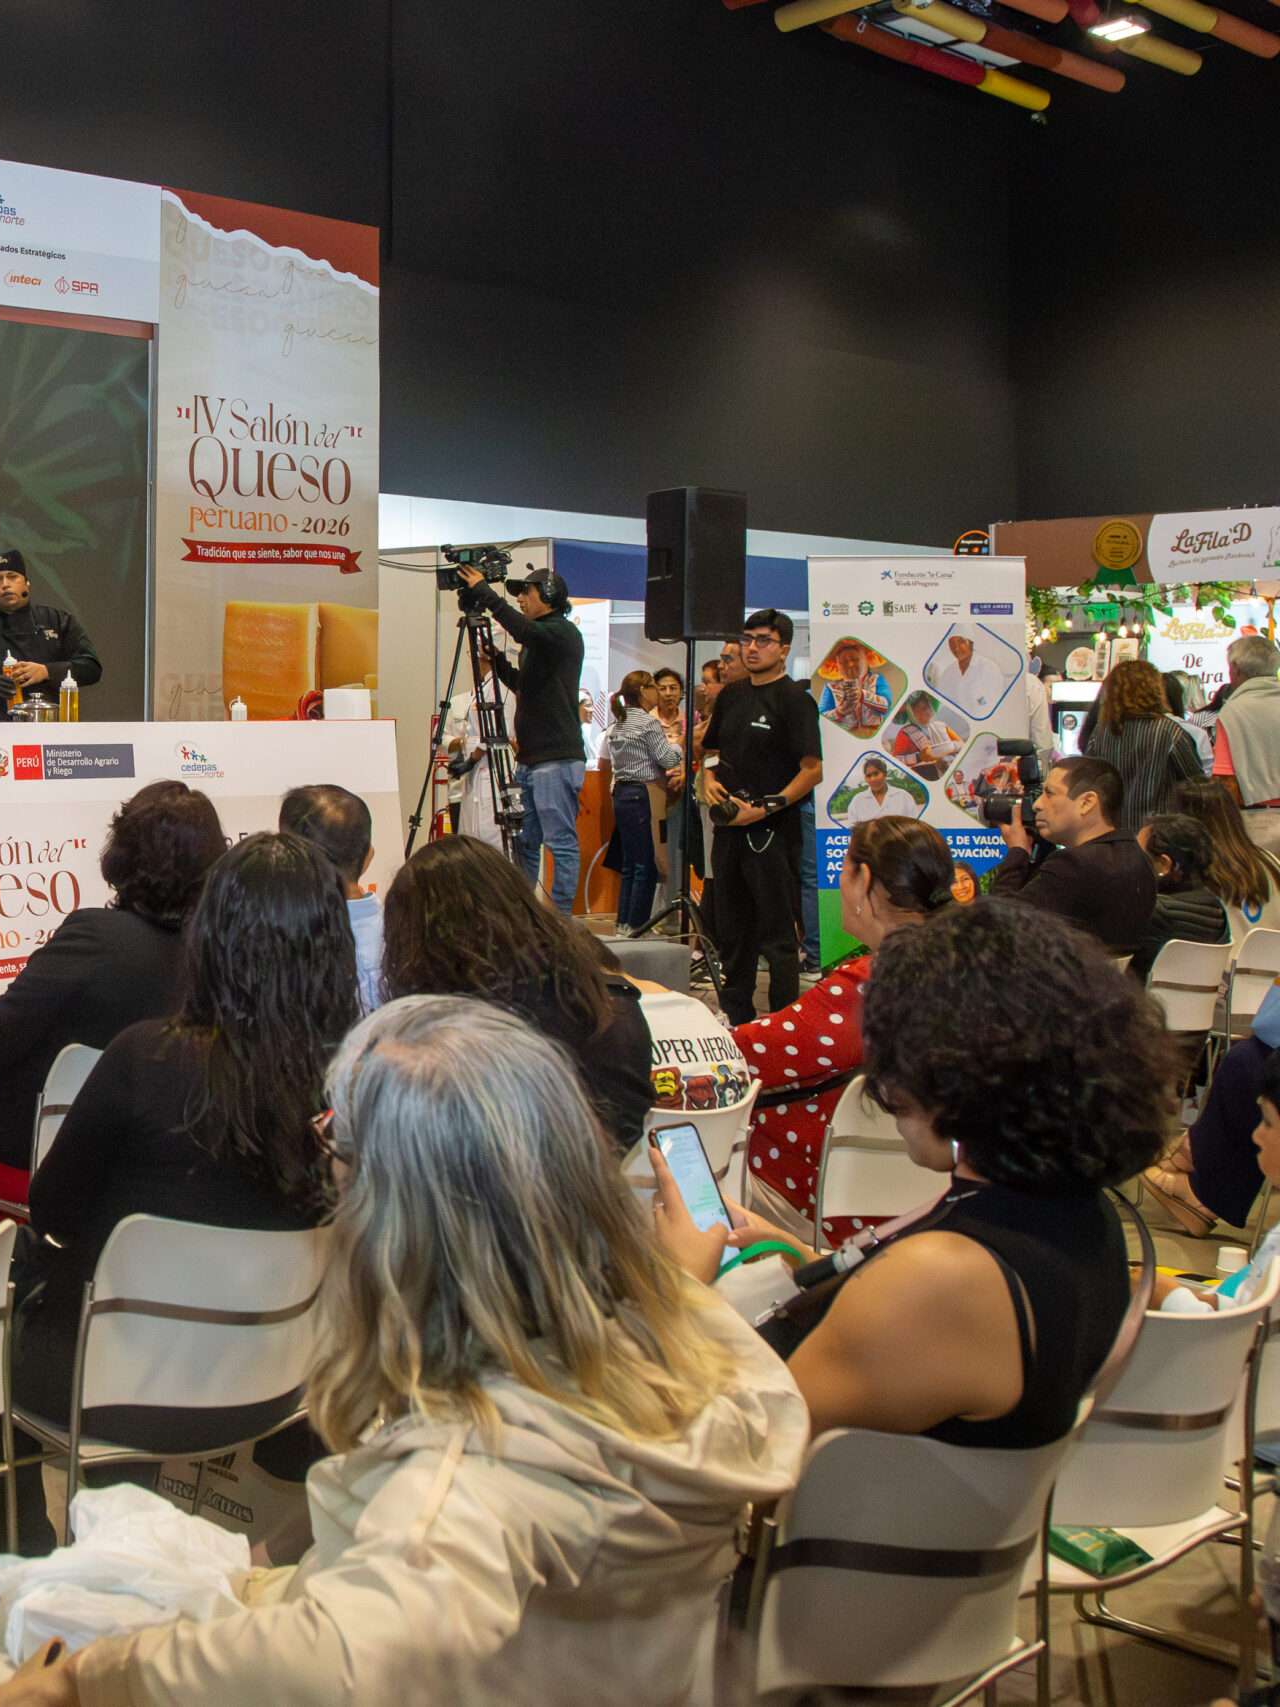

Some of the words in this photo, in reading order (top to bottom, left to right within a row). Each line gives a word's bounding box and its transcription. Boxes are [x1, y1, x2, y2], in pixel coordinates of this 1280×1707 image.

[71, 280, 99, 294] SPR
[193, 395, 226, 435] IV
[229, 397, 310, 446] Salón
[313, 422, 350, 449] del
[188, 435, 352, 508] Queso
[189, 505, 289, 534] peruano
[301, 513, 351, 537] 2026
[196, 544, 232, 559] Tradición
[232, 550, 246, 560] que
[247, 550, 256, 559] se
[256, 549, 282, 560] siente,
[283, 548, 303, 560] sabor
[304, 551, 318, 561] que
[318, 551, 331, 560] nos
[332, 552, 347, 561] une
[1182, 653, 1204, 669] De
[46, 749, 82, 757] Ministerio
[16, 755, 40, 768] PERÚ
[46, 757, 56, 766] de
[57, 757, 93, 766] Desarrollo
[94, 757, 119, 768] Agrario
[181, 763, 217, 774] cedepas
[47, 768, 52, 777] y
[53, 767, 73, 777] Riego
[956, 836, 970, 846] DE
[37, 839, 72, 863] del
[951, 846, 1004, 859] OVACIÓN,
[651, 1038, 699, 1066] UPER
